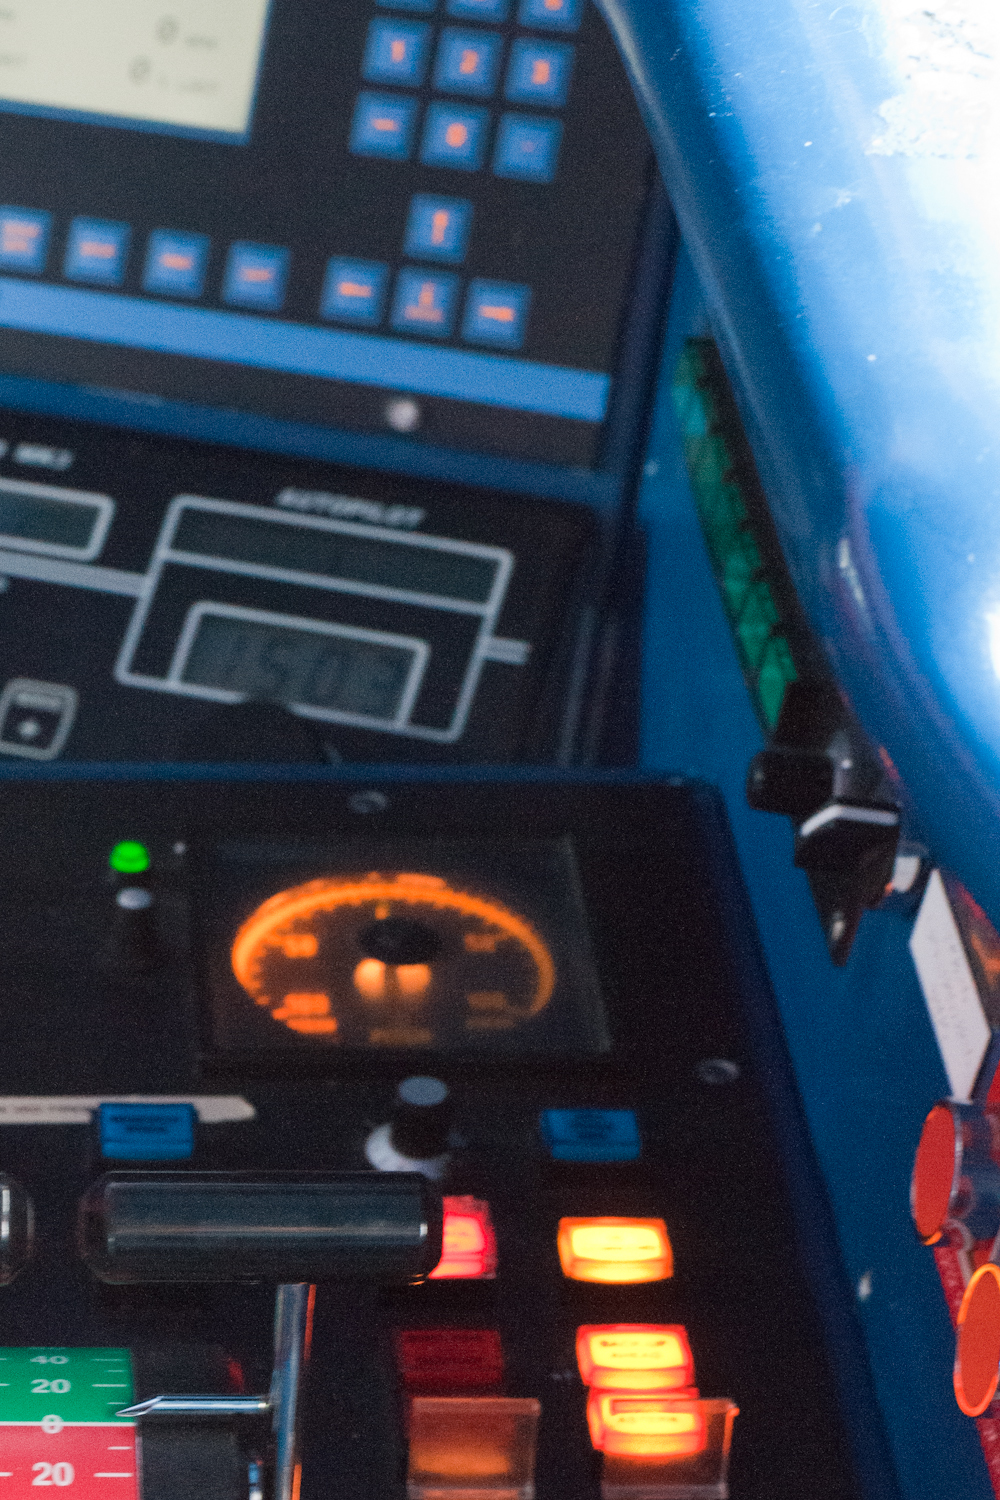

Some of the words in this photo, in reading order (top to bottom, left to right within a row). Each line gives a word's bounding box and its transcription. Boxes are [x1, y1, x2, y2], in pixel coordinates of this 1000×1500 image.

[30, 1356, 69, 1365] 40
[31, 1379, 71, 1394] 20
[41, 1414, 64, 1434] 0
[31, 1461, 75, 1487] 20
